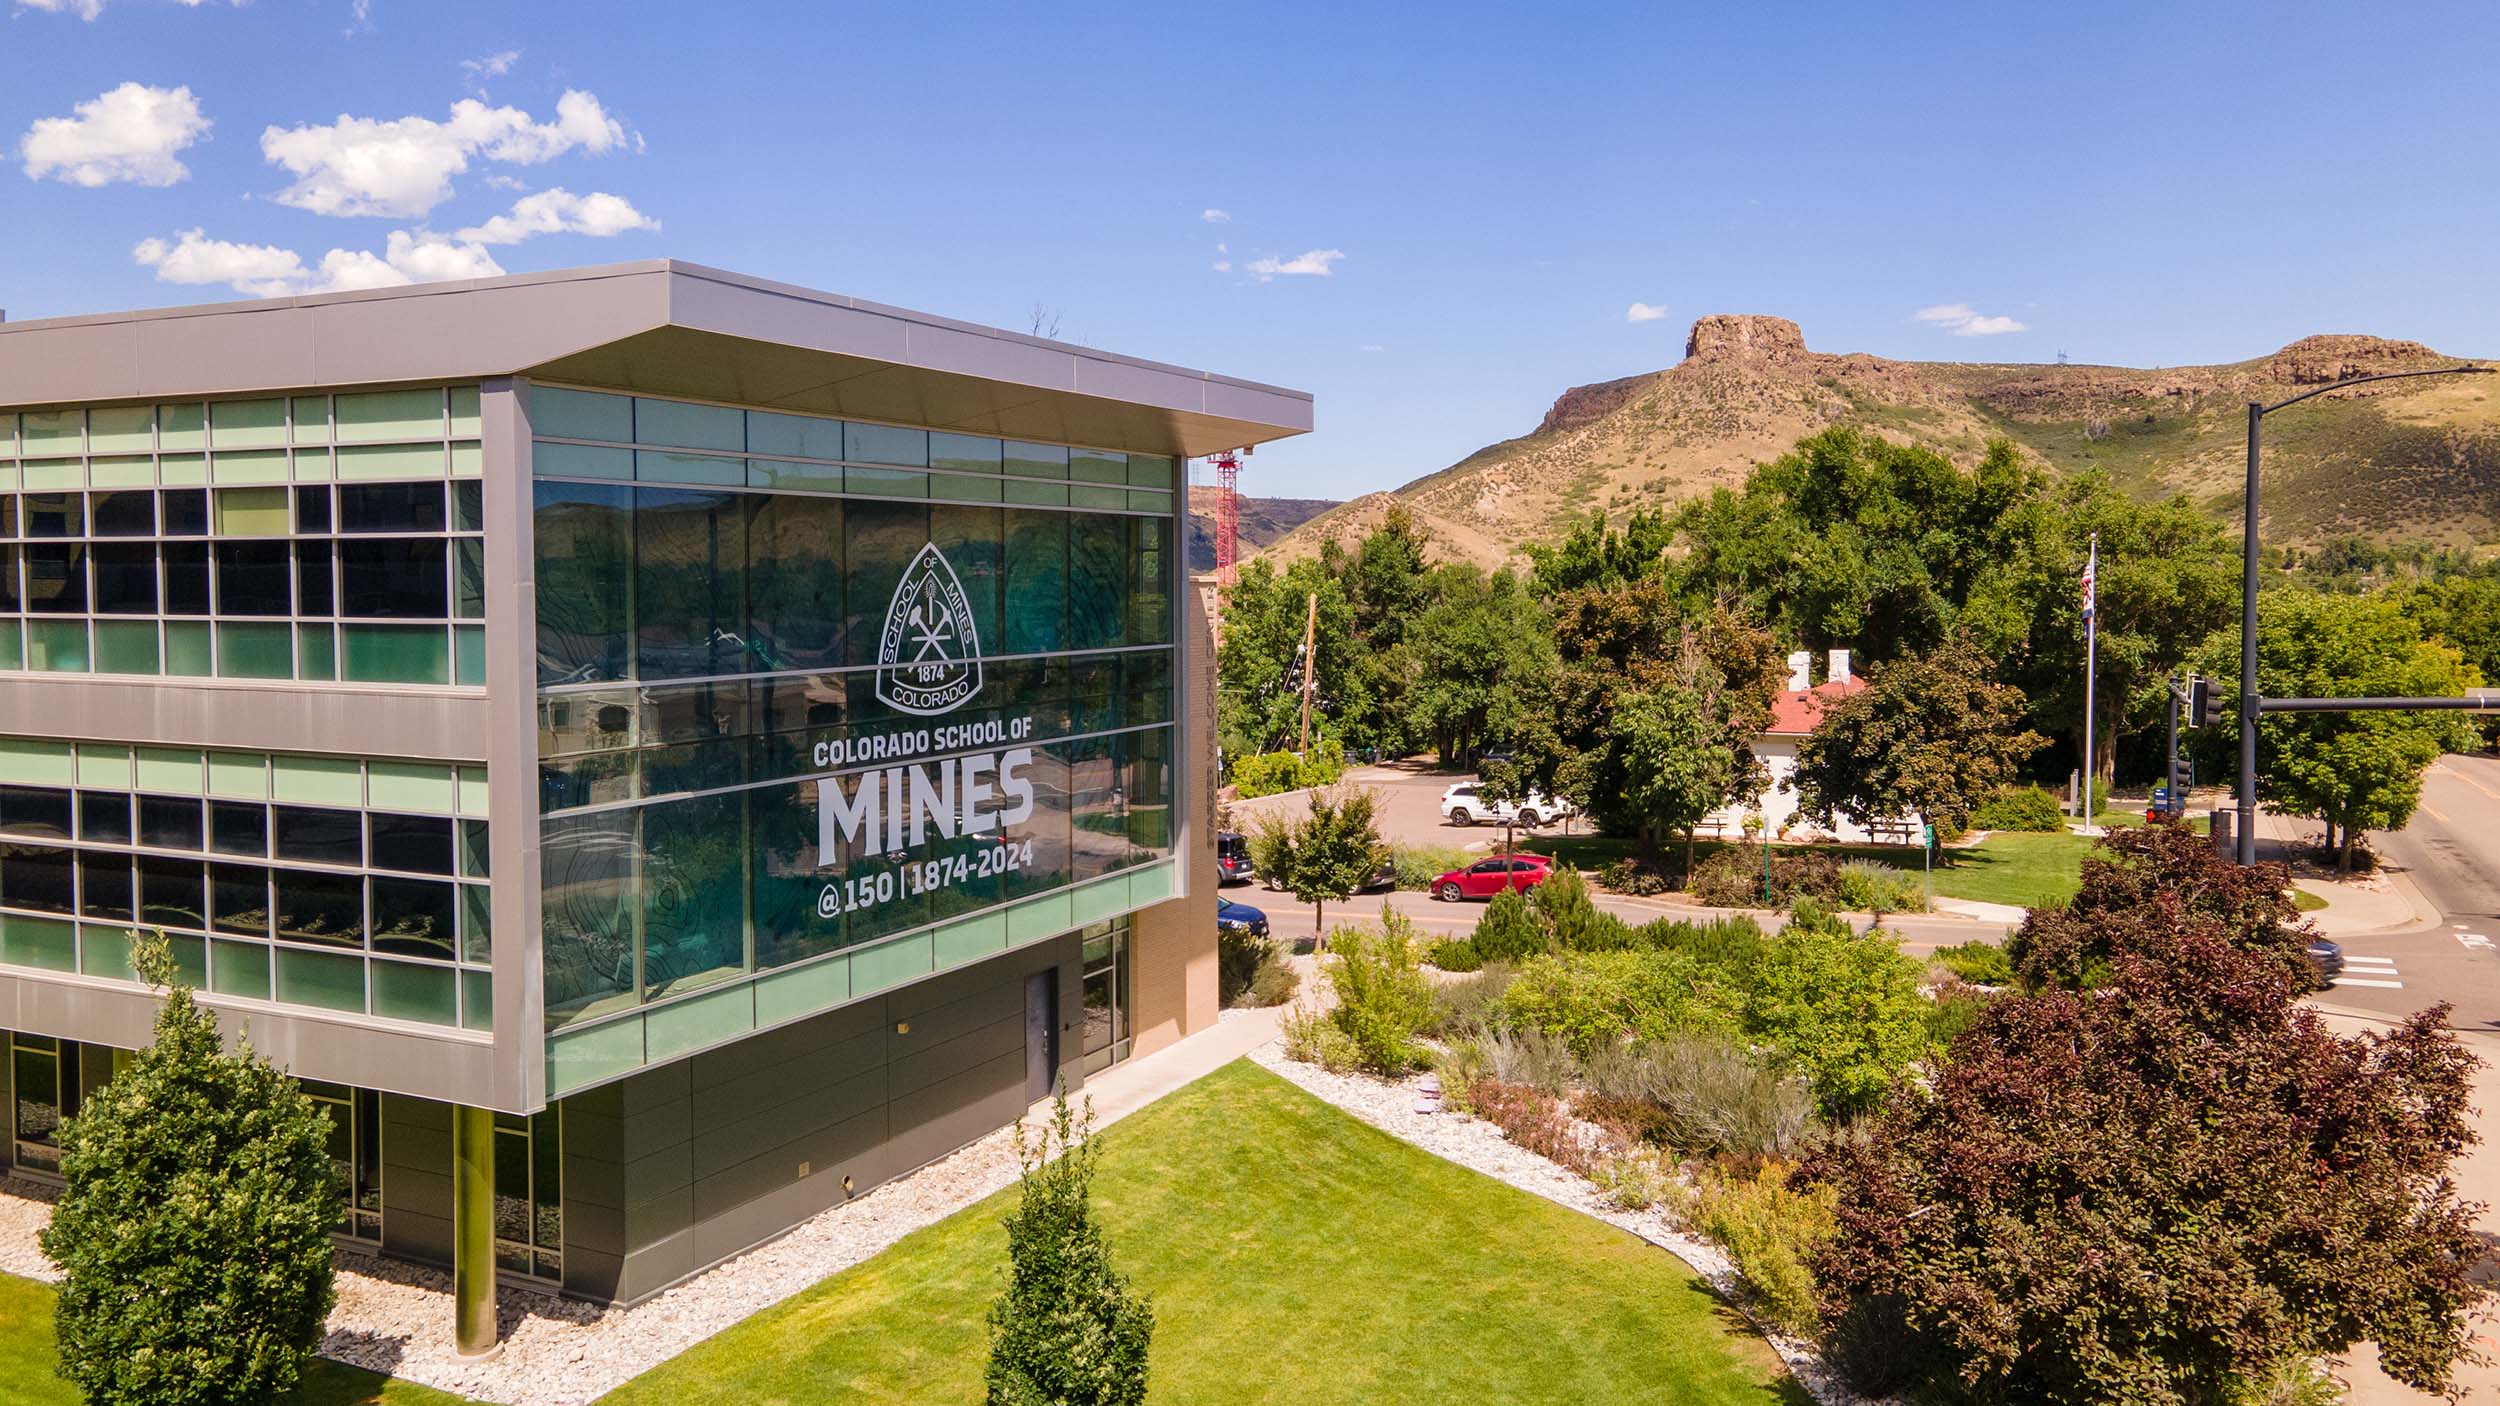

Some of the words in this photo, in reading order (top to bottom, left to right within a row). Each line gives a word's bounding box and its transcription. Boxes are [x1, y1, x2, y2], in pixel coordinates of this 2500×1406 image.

[885, 580, 918, 663] SCHOOL
[923, 558, 938, 569] OF
[947, 583, 972, 644] MINES
[892, 682, 968, 707] COLORADO
[917, 665, 945, 682] 1874
[1206, 666, 1214, 760] WELCOME
[813, 729, 930, 767] COLORADO
[934, 719, 1006, 752] SCHOOL
[1010, 717, 1032, 739] OF
[817, 748, 1033, 867] MINES
[912, 839, 1033, 895] 1874-2024
